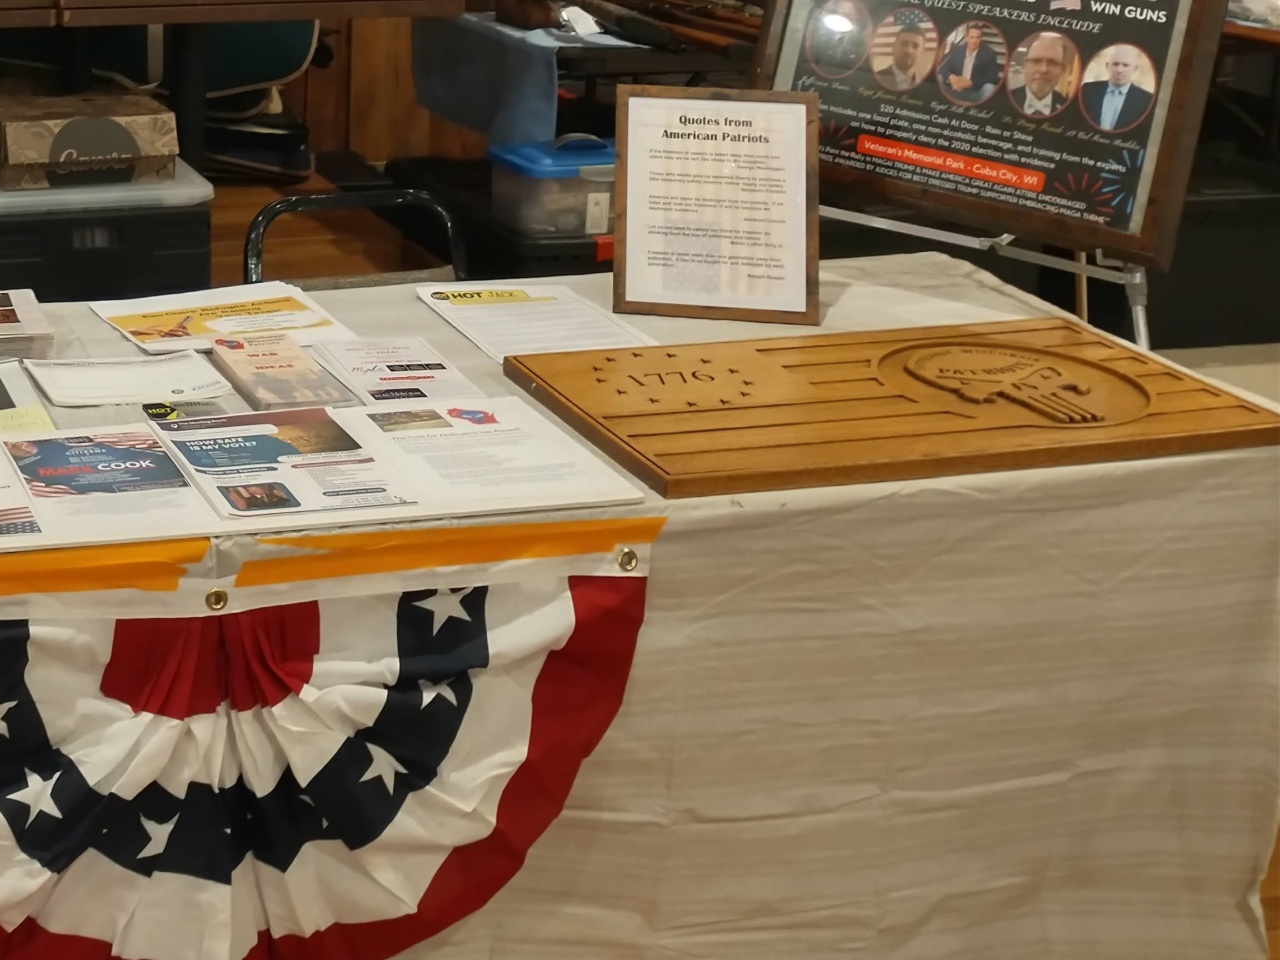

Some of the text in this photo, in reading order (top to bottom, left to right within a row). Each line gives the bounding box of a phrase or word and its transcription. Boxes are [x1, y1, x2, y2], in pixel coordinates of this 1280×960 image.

[966, 3, 1037, 23] SPEAKERS
[1039, 15, 1103, 33] INCLUDE
[1090, 0, 1121, 16] WIN
[1124, 6, 1167, 23] GUNS
[679, 115, 752, 127] Quotes from
[895, 108, 930, 120] Admission
[931, 115, 950, 124] Cash
[950, 118, 960, 127] At
[960, 120, 980, 131] Door
[985, 126, 1002, 135] Rain
[1013, 130, 1034, 142] Shine
[662, 129, 769, 143] American Patriots
[863, 140, 902, 156] Veteran's
[903, 148, 944, 165] Memorial
[945, 157, 965, 170] Park
[972, 163, 997, 178] Cuba
[1023, 175, 1039, 186] WI
[938, 136, 950, 146] the
[951, 140, 971, 150] 2020
[972, 145, 1002, 158] election
[1003, 152, 1020, 162] with
[1021, 156, 1055, 169] evidence
[627, 370, 715, 386] 1776
[97, 460, 156, 471] COOK
